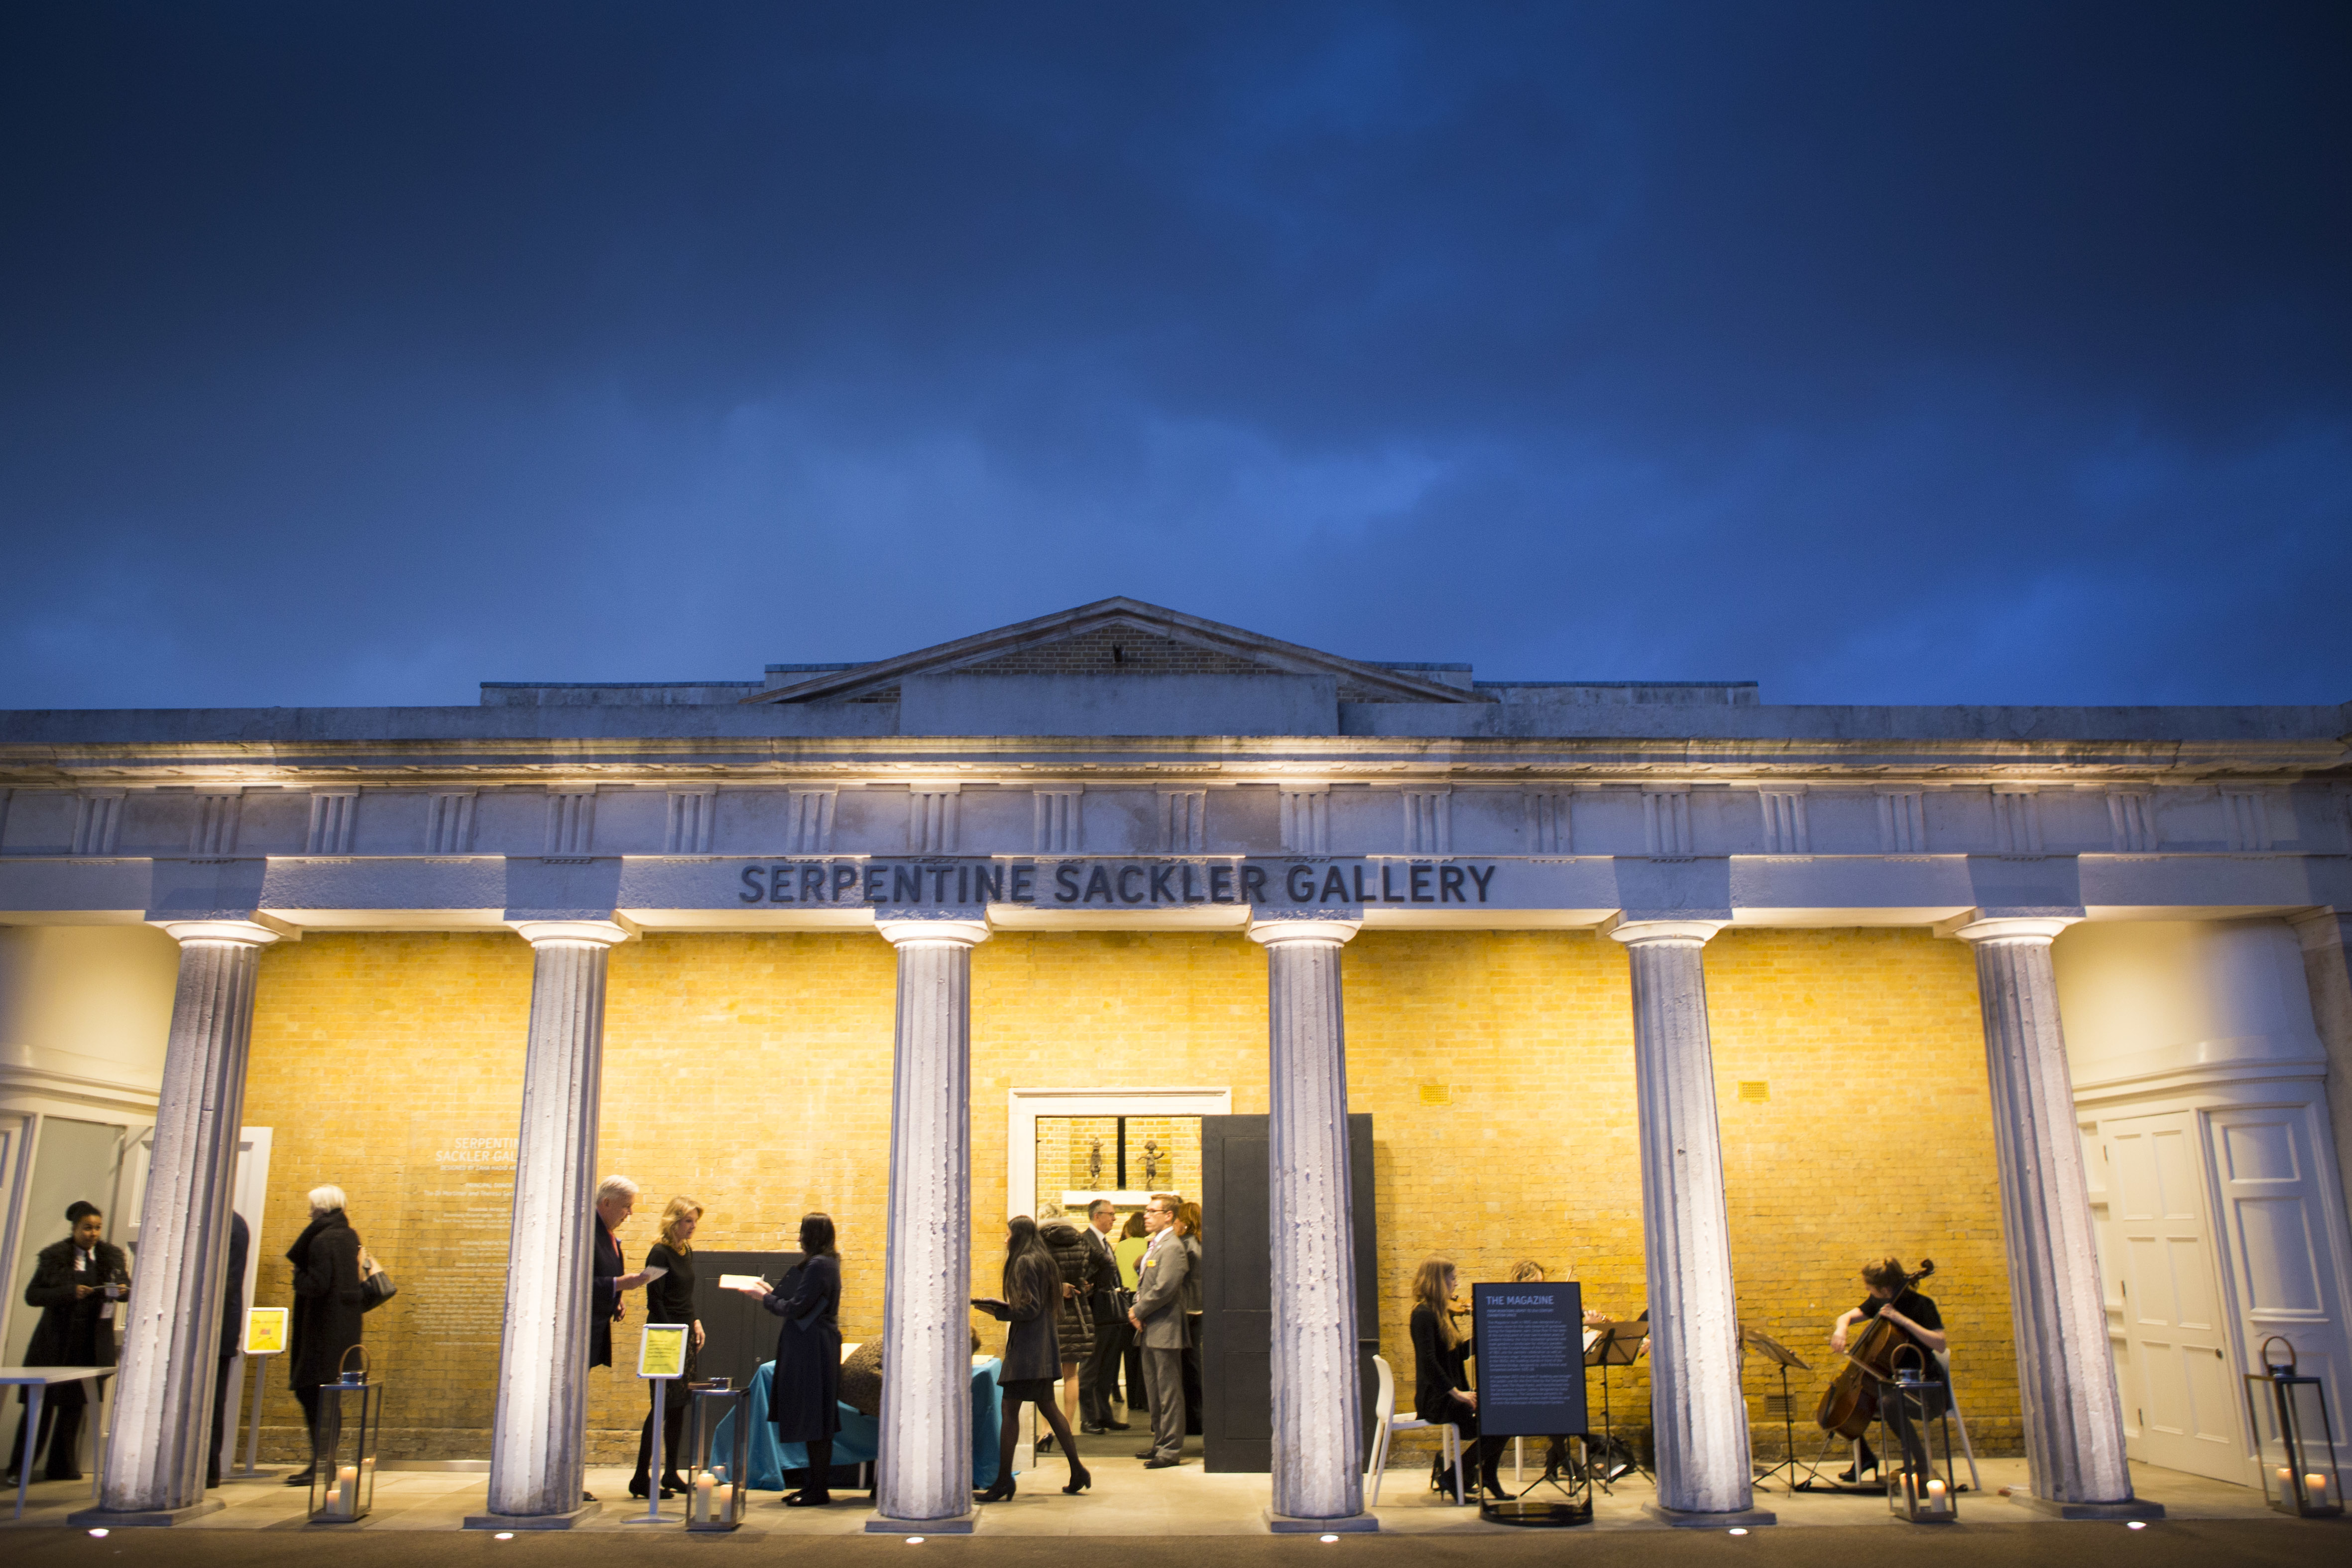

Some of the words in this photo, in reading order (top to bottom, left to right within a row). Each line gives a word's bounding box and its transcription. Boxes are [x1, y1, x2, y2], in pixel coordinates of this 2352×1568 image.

[739, 864, 1036, 903] SERPENTINE
[1054, 864, 1266, 903] SACKLER
[1286, 864, 1496, 903] GALLERY
[454, 1137, 519, 1149] SERPENTIN
[435, 1150, 490, 1162] SACKLER
[493, 1150, 518, 1162] GAL
[1486, 1296, 1504, 1305] THE
[1507, 1295, 1553, 1305] MAGAZINE
